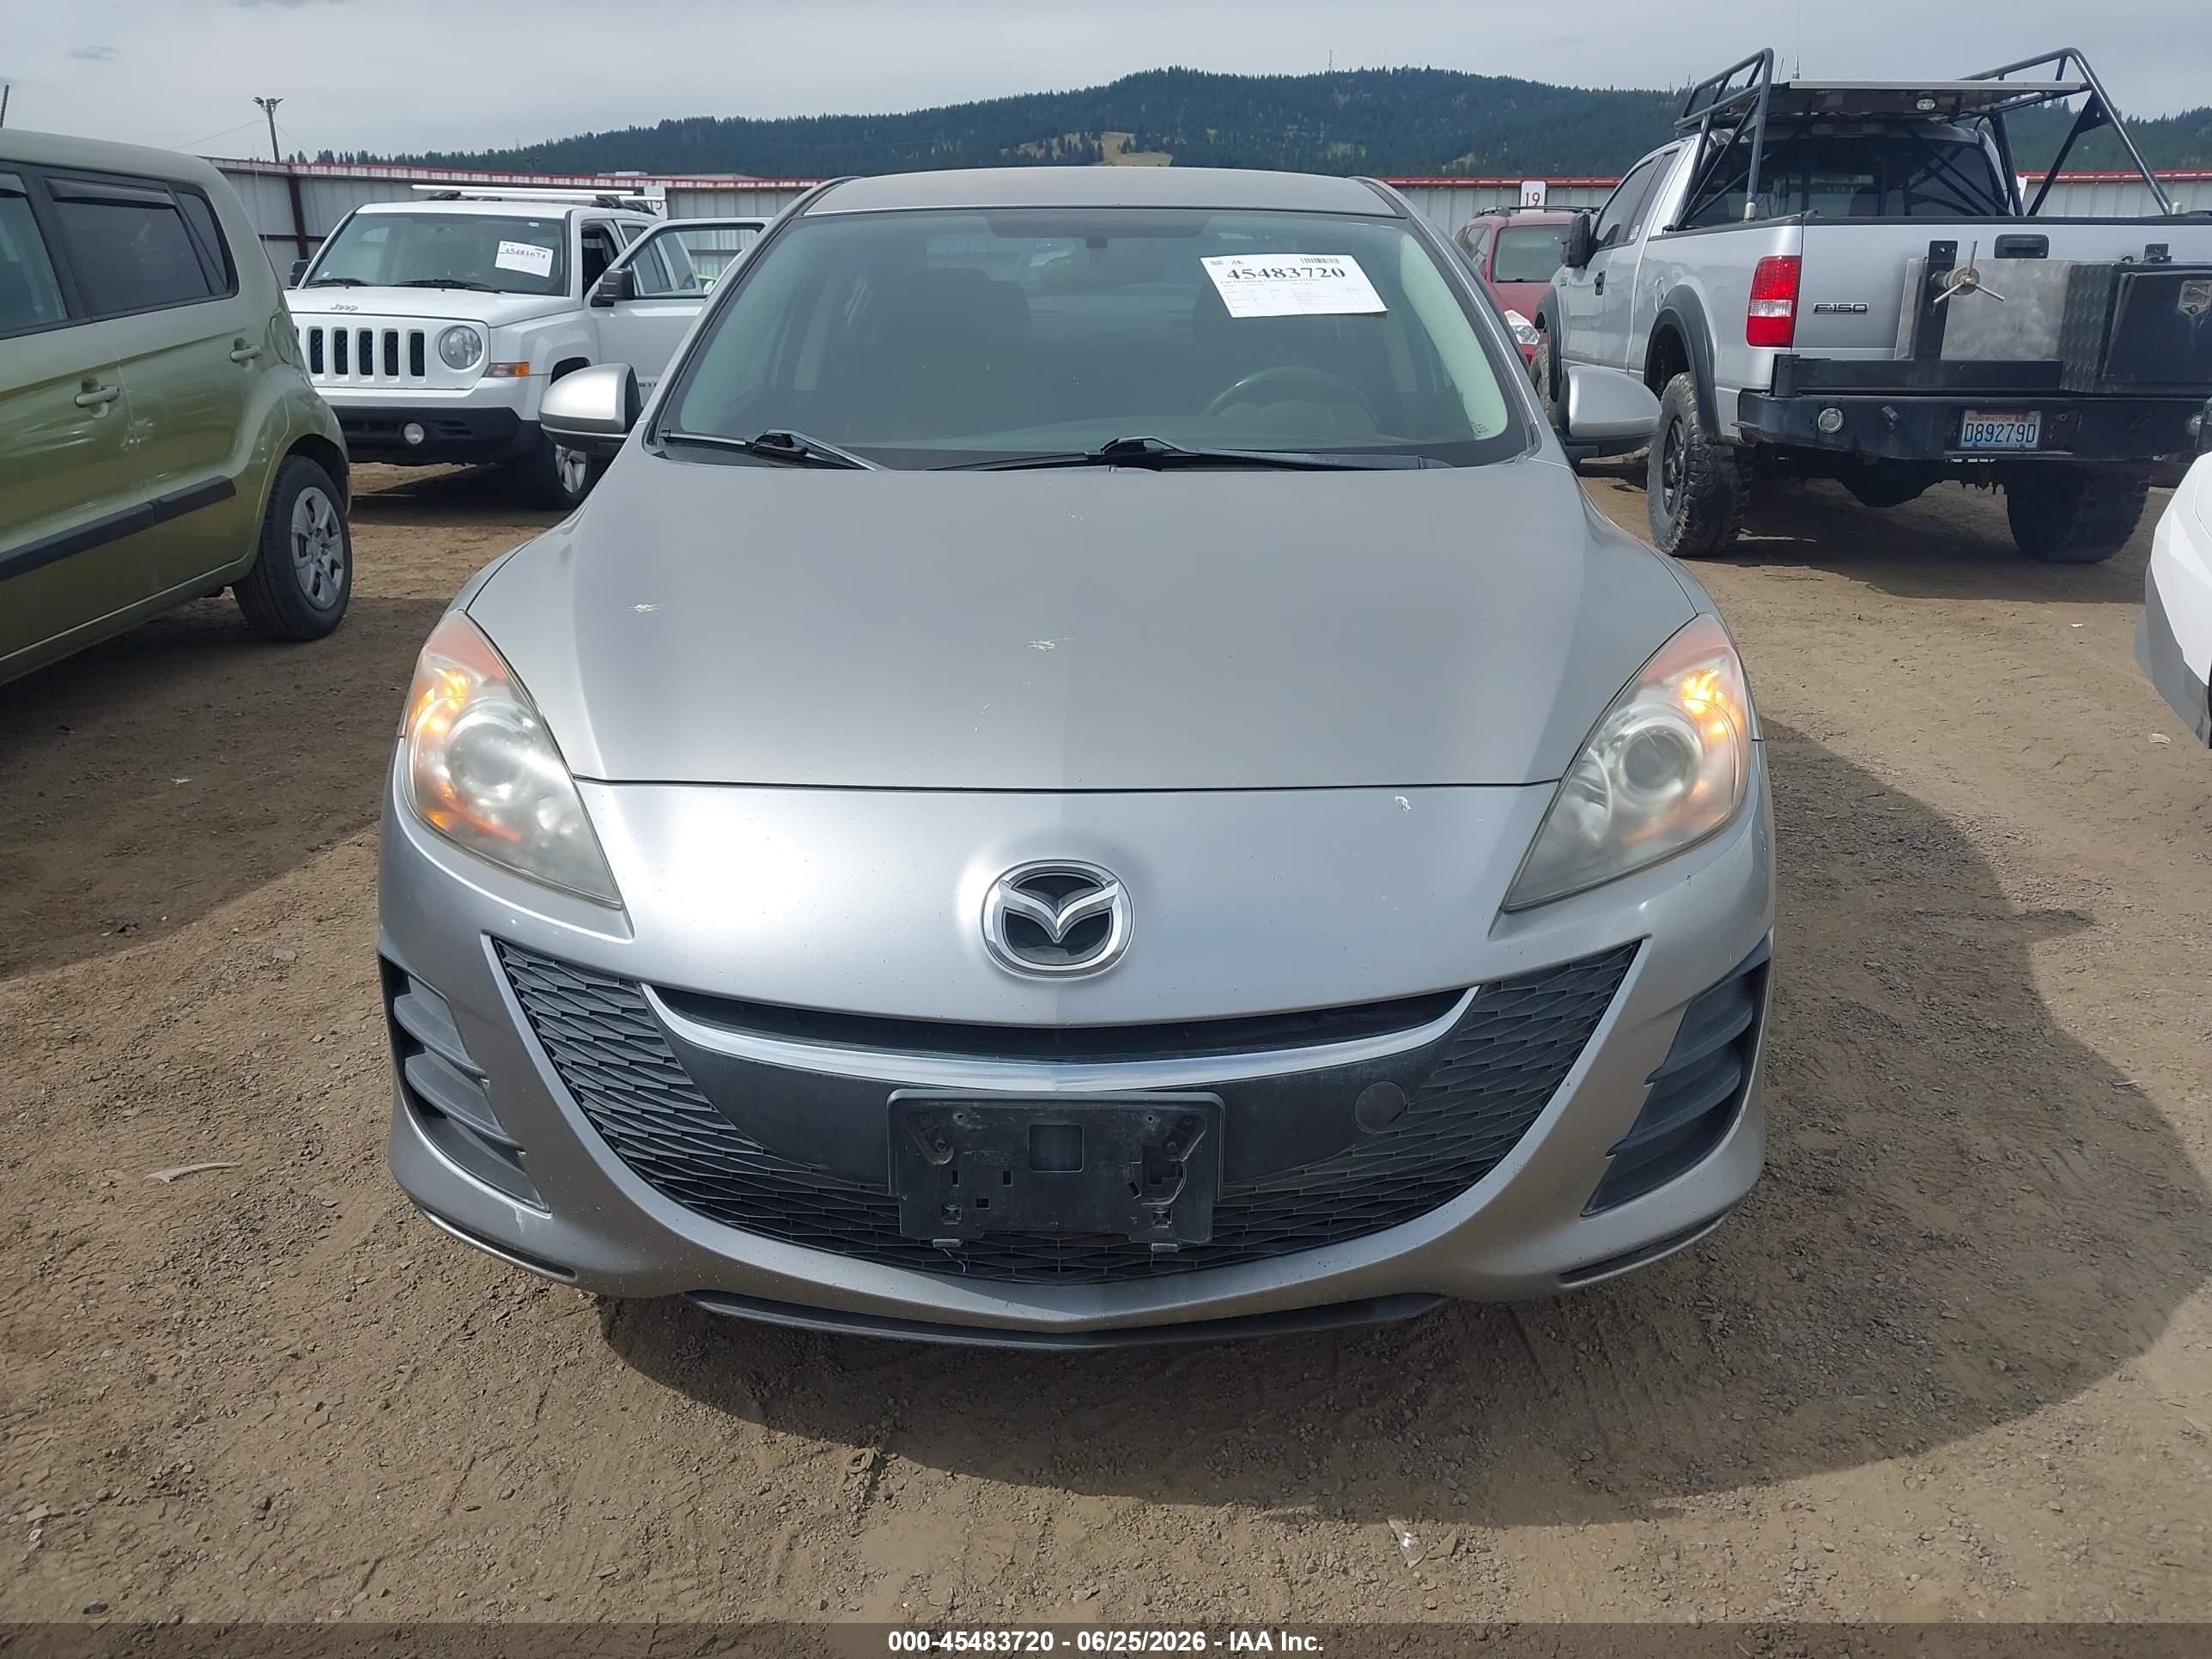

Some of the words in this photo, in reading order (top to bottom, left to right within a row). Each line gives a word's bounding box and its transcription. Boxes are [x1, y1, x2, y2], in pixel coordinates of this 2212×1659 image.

[1525, 191, 1540, 207] 19
[1227, 267, 1346, 279] 45483720
[330, 302, 358, 312] Jeep
[1964, 423, 2036, 443] D89279D
